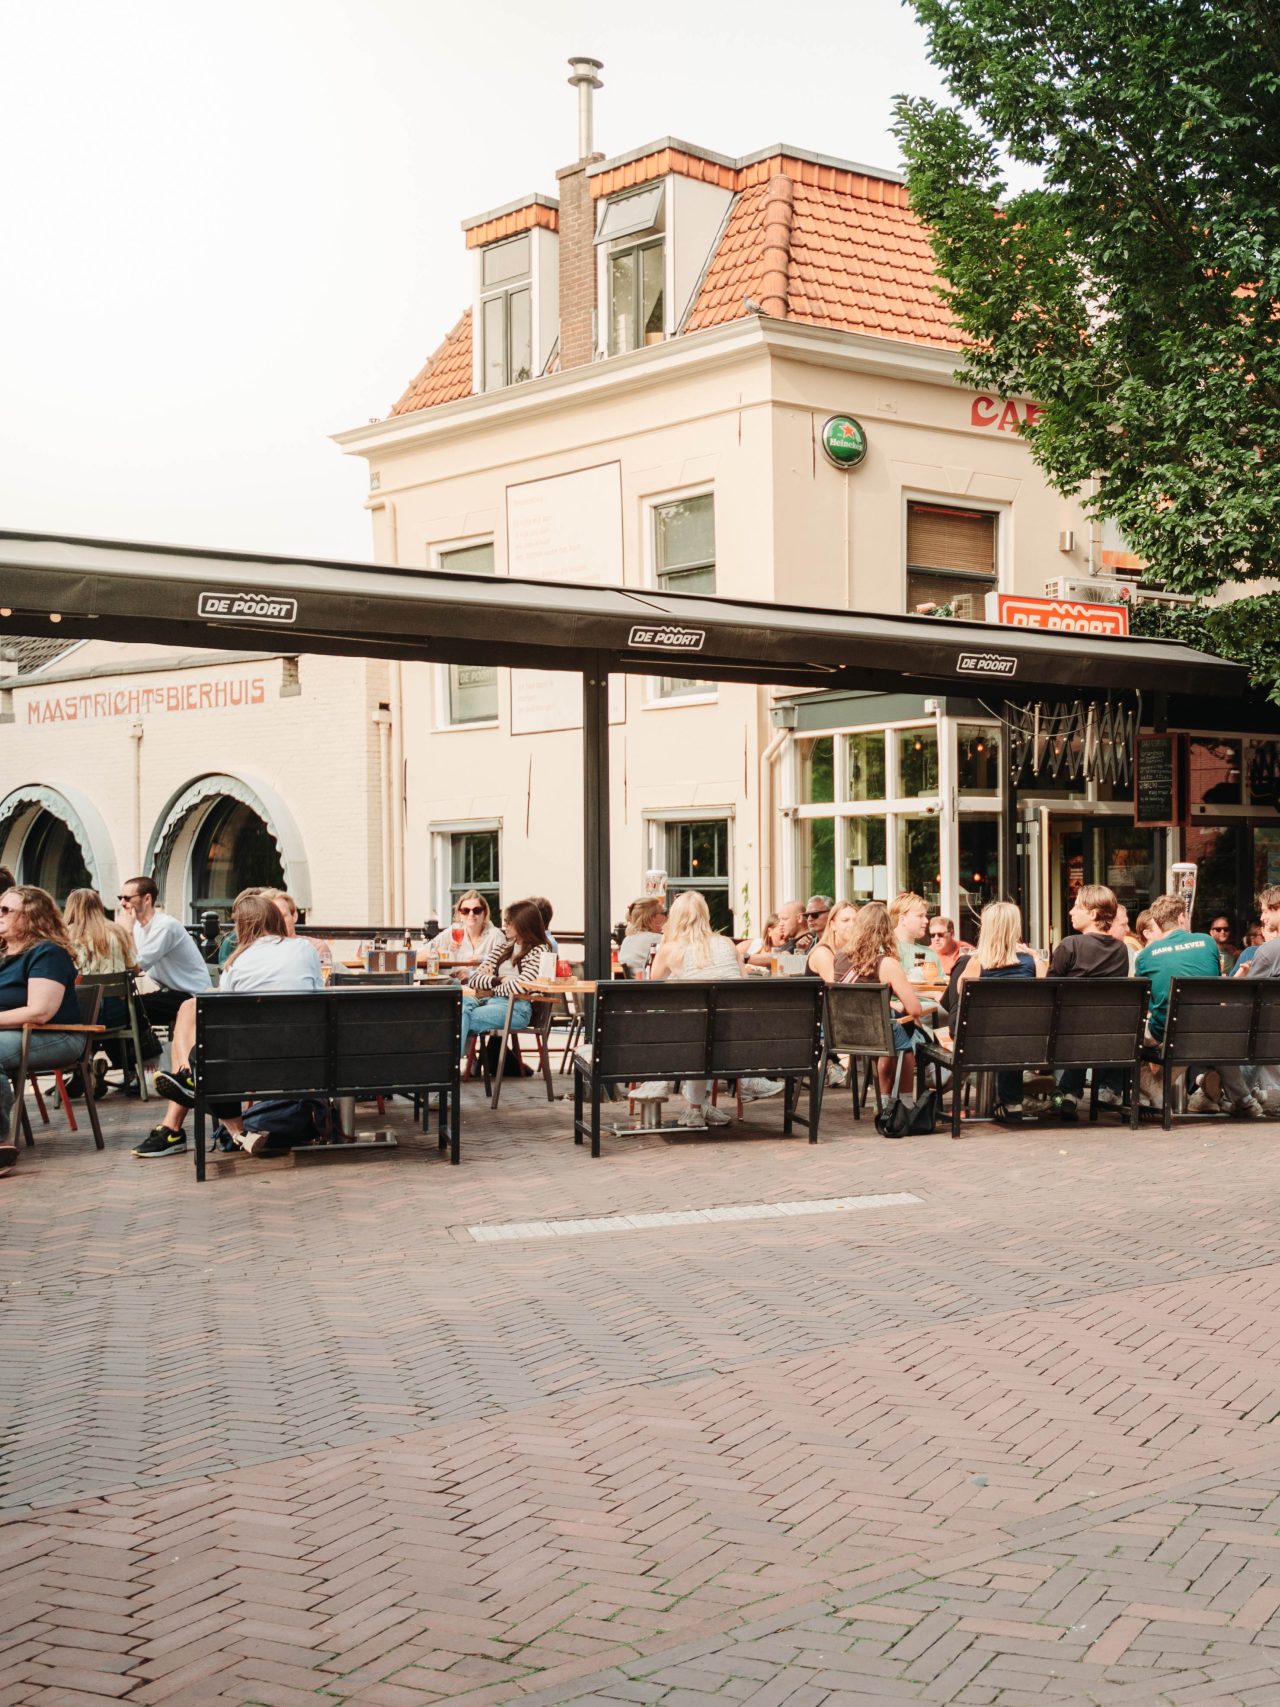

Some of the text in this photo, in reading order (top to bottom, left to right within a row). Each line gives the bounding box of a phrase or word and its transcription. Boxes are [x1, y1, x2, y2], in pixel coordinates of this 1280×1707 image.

[829, 437, 863, 451] Heineken
[204, 599, 291, 617] DE POORT
[633, 631, 700, 645] DE POORT
[961, 658, 1013, 672] DE POORT
[1174, 940, 1206, 952] ELEVEN
